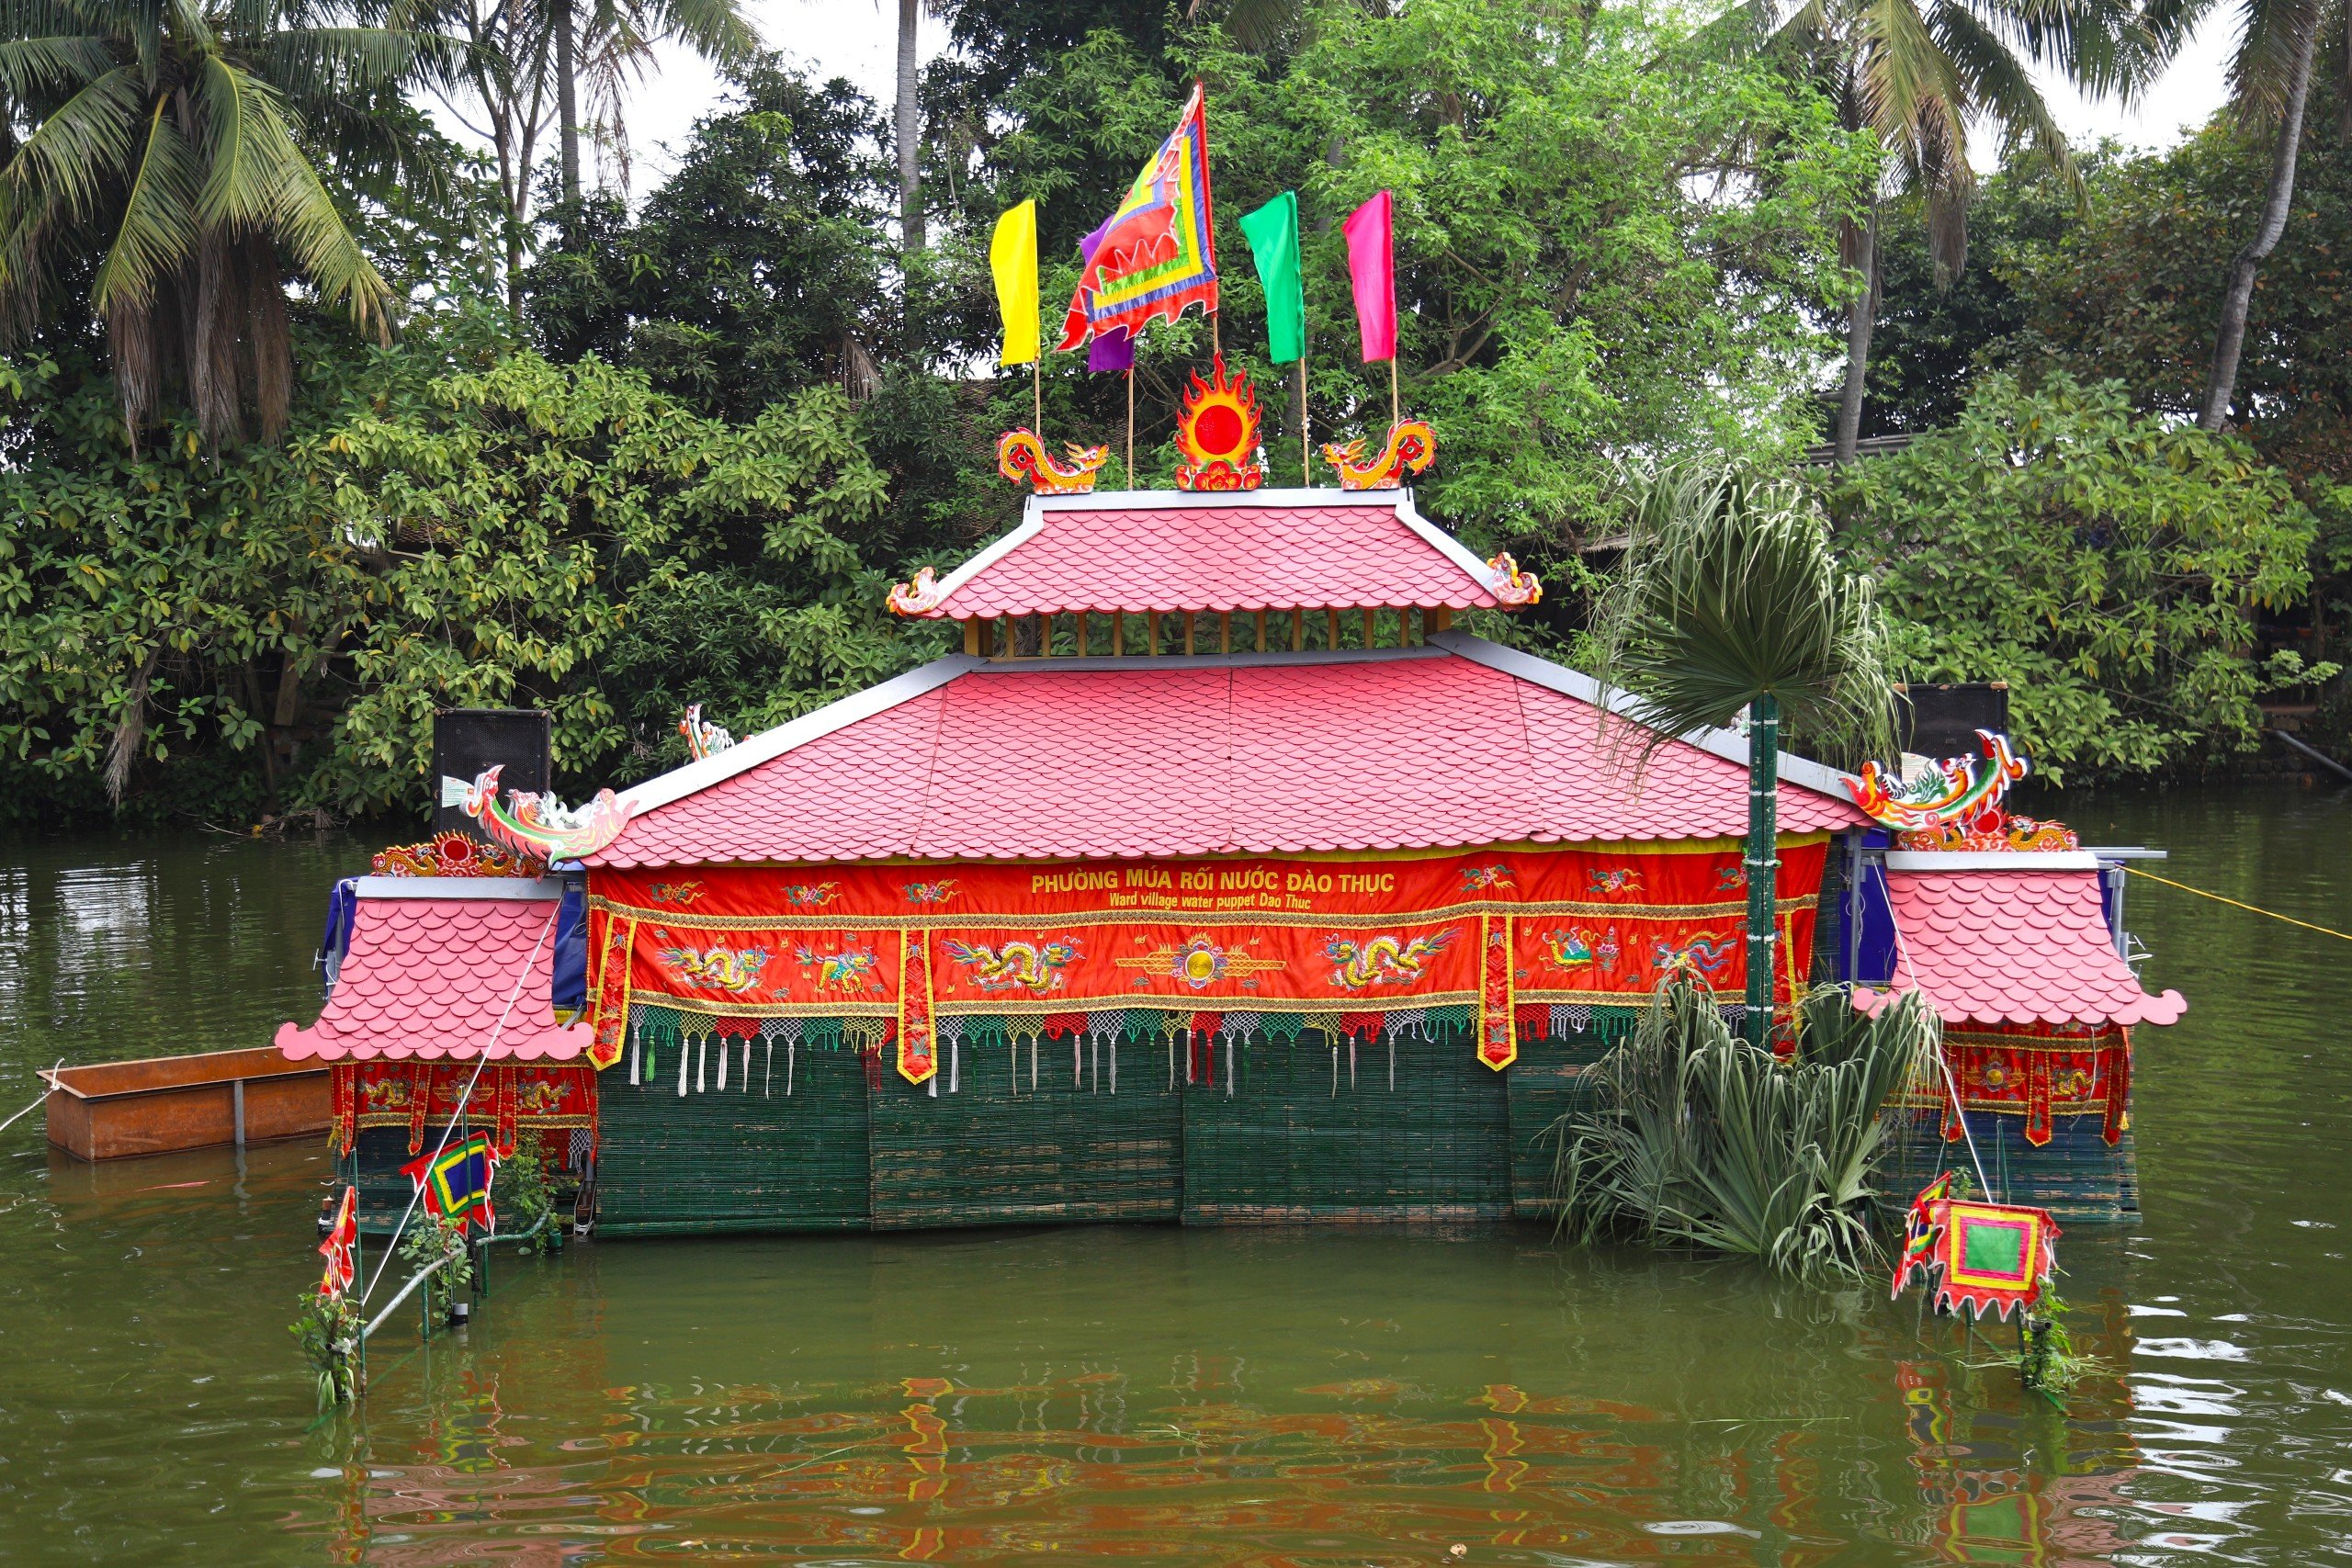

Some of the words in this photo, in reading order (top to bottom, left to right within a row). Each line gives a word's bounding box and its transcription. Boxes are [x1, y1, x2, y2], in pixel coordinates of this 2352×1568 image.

[1125, 865, 1172, 889] MÚA
[1180, 866, 1214, 891] RỐI
[1220, 865, 1279, 890] NƯỚC
[1286, 869, 1332, 893] ĐÀO
[1338, 874, 1395, 897] THỤC
[1109, 891, 1137, 907] Ward
[1140, 892, 1178, 910] village
[1182, 895, 1214, 908] water
[1216, 894, 1255, 911] puppet
[1259, 892, 1282, 908] Dao
[1285, 894, 1311, 910] Thuc
